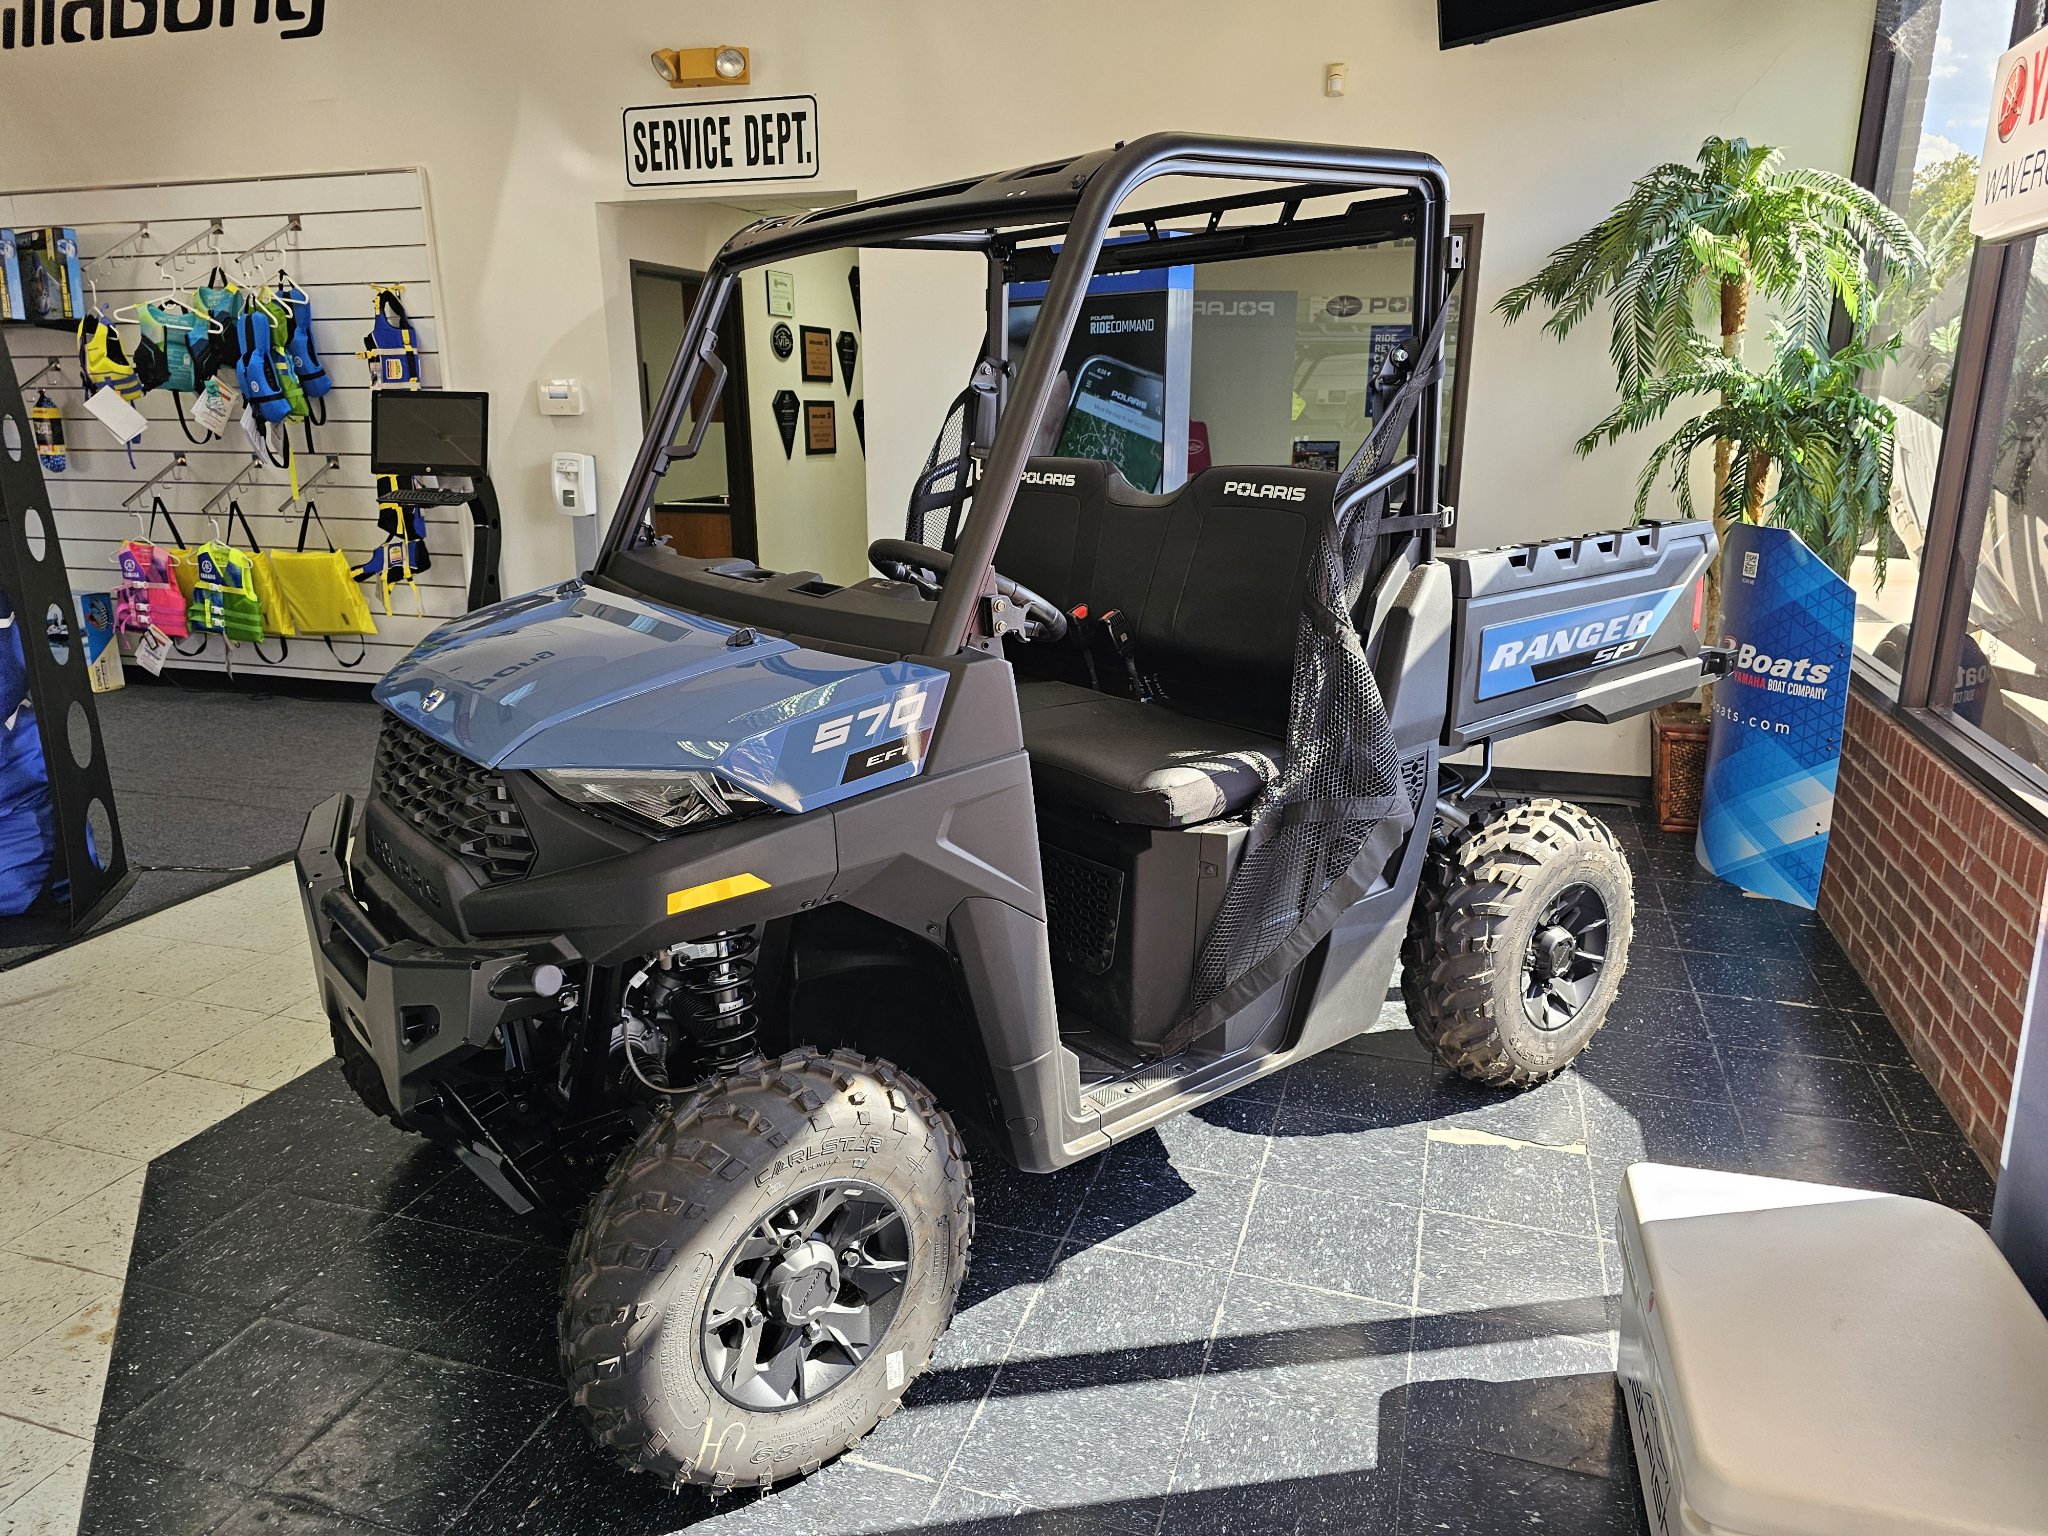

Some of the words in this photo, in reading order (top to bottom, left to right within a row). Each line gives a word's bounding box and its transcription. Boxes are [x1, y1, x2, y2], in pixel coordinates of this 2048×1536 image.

[633, 116, 733, 173] SERVICE
[744, 111, 812, 167] DEPT.
[1984, 150, 2048, 206] WAVER
[1375, 334, 1400, 343] RIDE.
[1110, 390, 1147, 410] POLARIS
[1224, 481, 1307, 502] POLARIS
[1488, 610, 1654, 673] RANGER
[1591, 641, 1638, 665] SP
[1737, 643, 1831, 684] Boats
[1734, 671, 1766, 690] YAMAHA
[1767, 678, 1787, 694] BOAT
[1787, 682, 1828, 701] COMPANY
